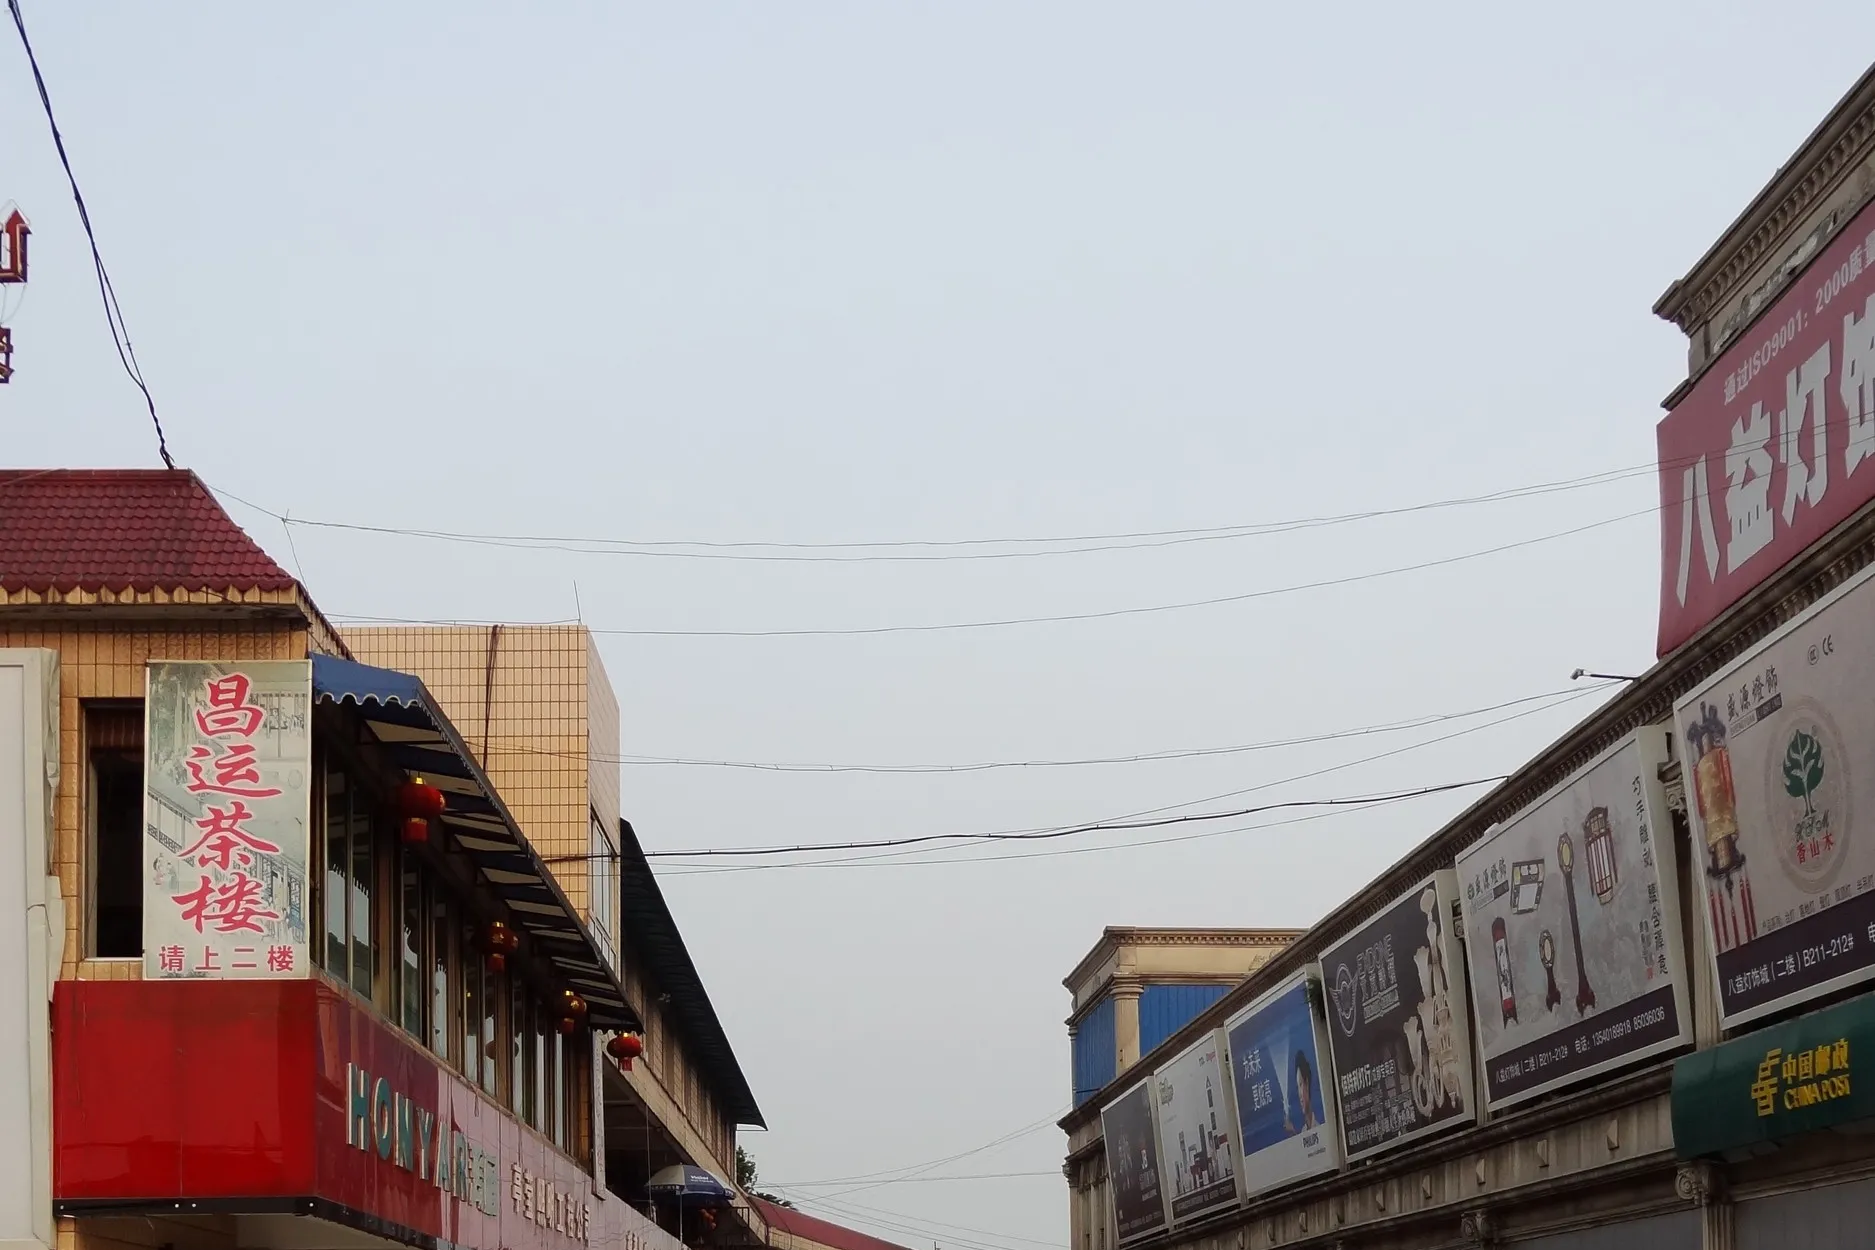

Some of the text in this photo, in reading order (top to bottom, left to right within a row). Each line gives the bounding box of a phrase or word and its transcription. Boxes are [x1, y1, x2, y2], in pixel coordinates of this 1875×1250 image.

[171, 672, 283, 935] 昌运茶楼
[1796, 832, 1834, 865] 香山木
[158, 945, 294, 973] 请上二楼
[1782, 1038, 1849, 1084] 中国邮政
[1784, 1074, 1850, 1110] CHINA POST
